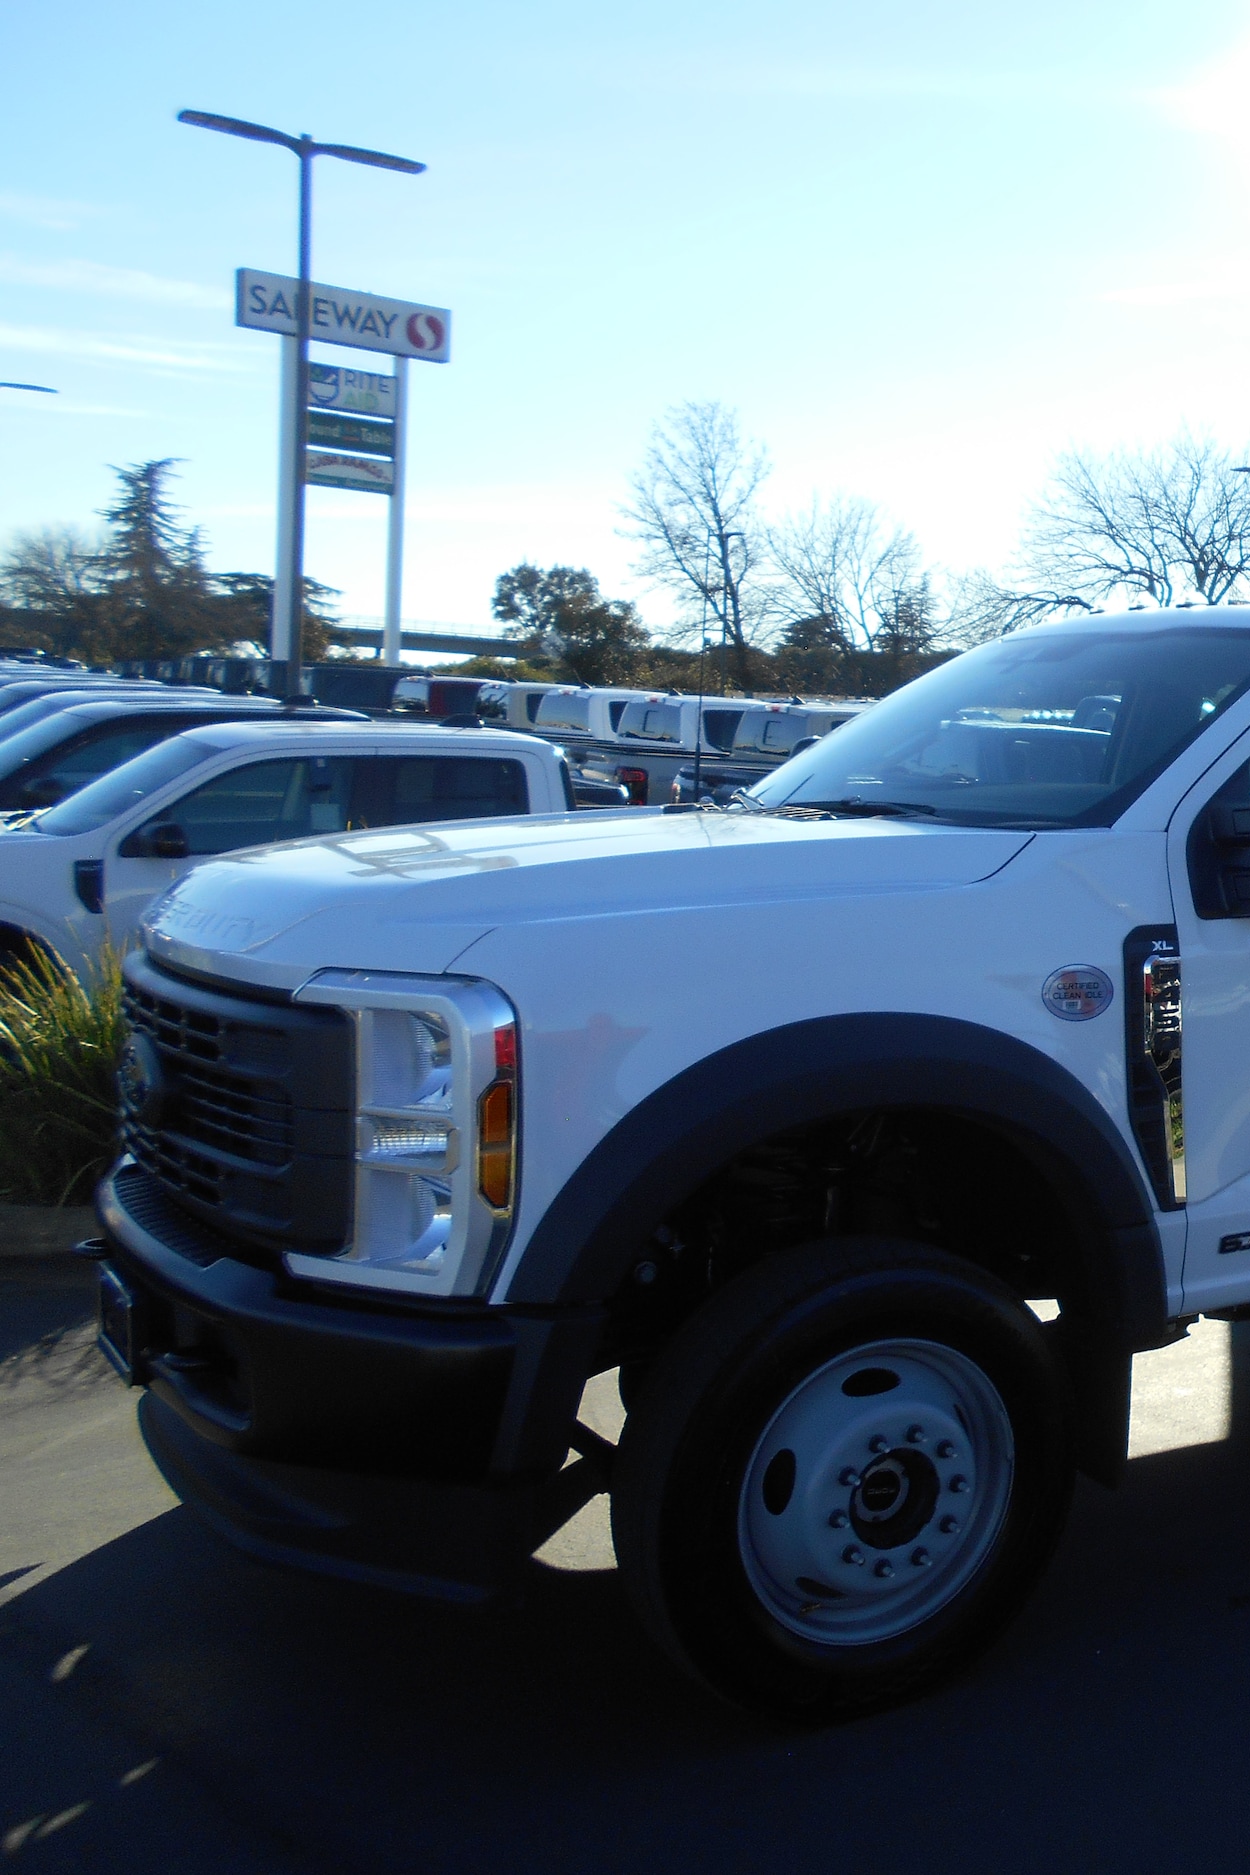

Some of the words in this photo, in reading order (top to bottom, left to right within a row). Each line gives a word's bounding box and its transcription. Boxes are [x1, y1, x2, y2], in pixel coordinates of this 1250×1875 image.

[344, 368, 390, 394] RITE
[1151, 940, 1174, 951] XL
[1056, 982, 1099, 990] CERTIFIED
[1053, 991, 1081, 1000] CLEAN
[1085, 990, 1104, 998] IDLE
